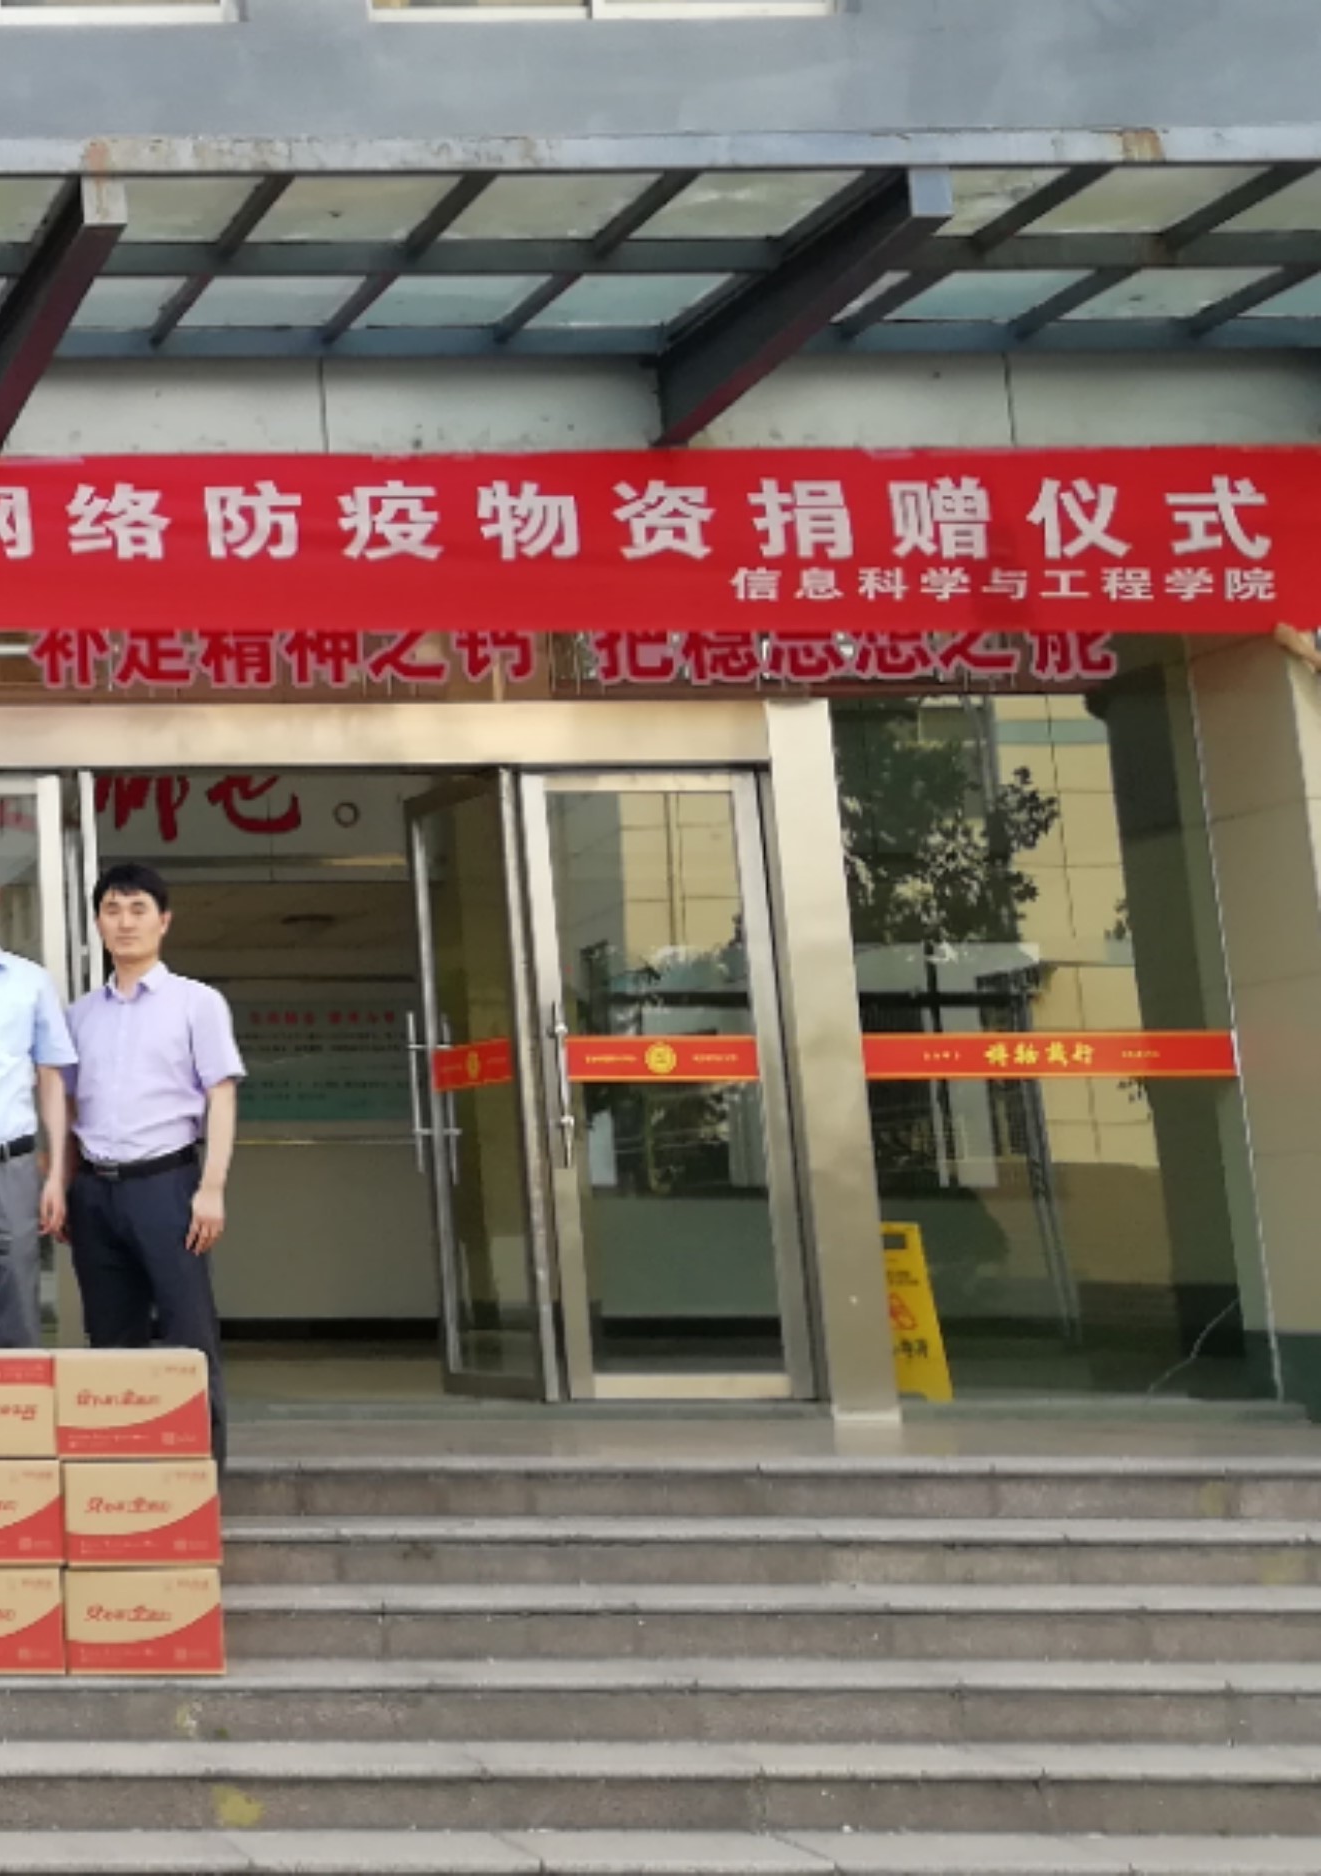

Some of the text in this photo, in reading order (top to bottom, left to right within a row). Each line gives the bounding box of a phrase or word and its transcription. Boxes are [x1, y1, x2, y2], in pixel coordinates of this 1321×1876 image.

[730, 567, 1277, 603] 信息科学与工程学院
